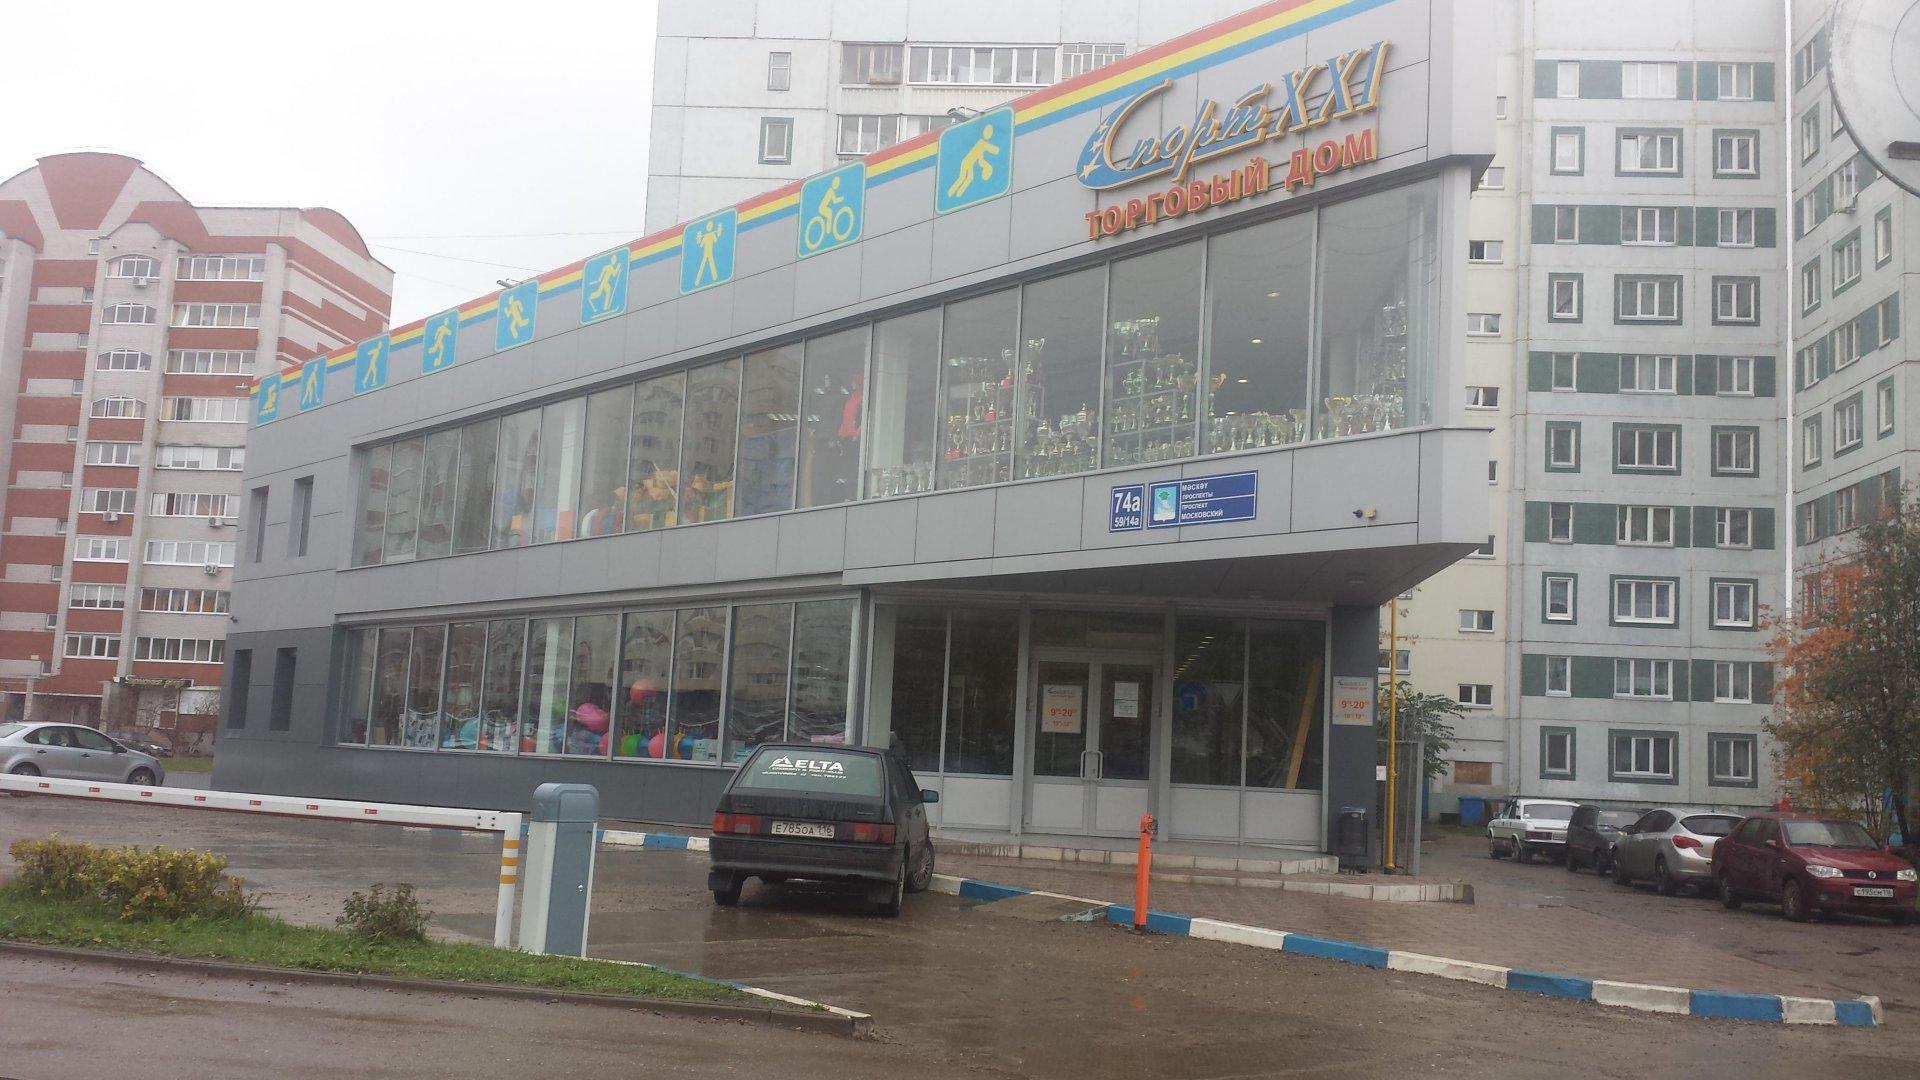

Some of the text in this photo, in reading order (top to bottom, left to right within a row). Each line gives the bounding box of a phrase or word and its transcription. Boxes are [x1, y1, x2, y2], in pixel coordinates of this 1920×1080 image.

[1084, 127, 1378, 240] ТОРГОВЫЙ ДОМ
[1182, 492, 1214, 500] ПРОСПЕКТЫ
[1114, 491, 1141, 514] 74а
[1181, 502, 1208, 510] ПРОСПЕКТ
[1181, 509, 1224, 520] МОСКОВСКИЙ
[1114, 515, 1140, 527] 59/14а
